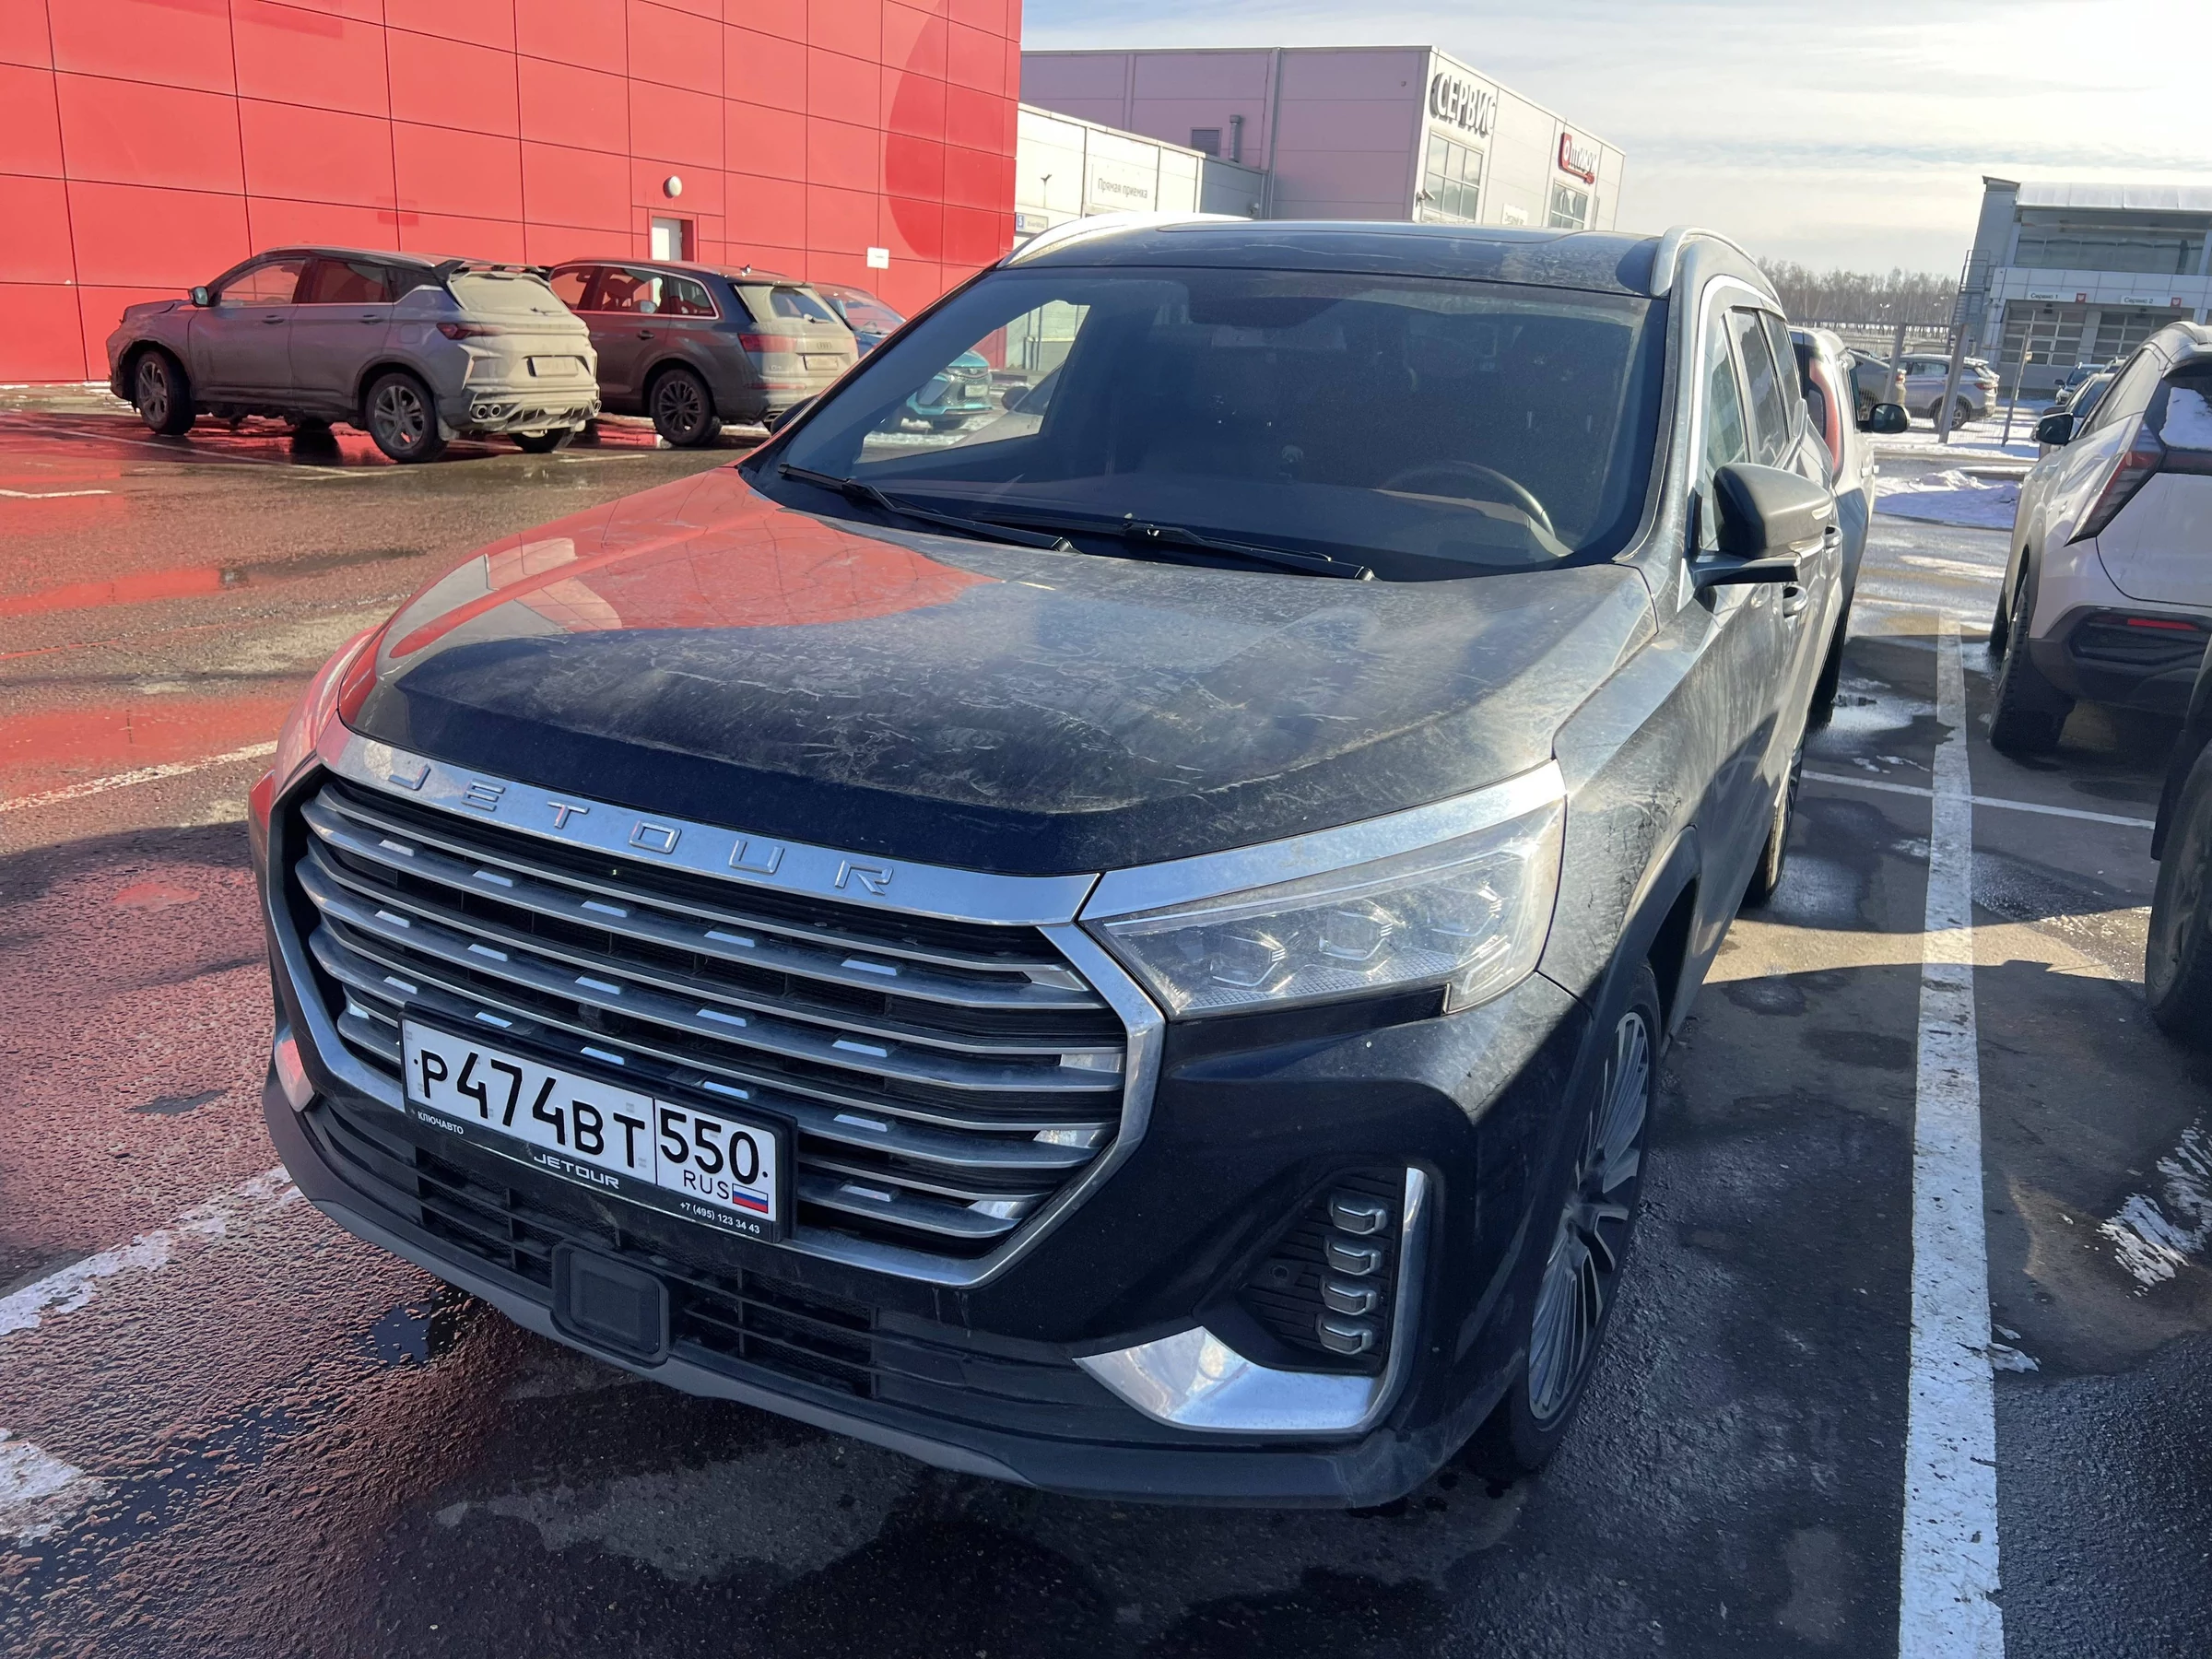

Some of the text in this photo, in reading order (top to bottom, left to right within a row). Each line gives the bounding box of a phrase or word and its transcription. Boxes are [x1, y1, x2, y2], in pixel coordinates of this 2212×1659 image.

[1430, 72, 1497, 137] СЕРВИС
[388, 764, 893, 896] JETOUR
[417, 1111, 465, 1135] КЛЮЧАВТО
[659, 1108, 759, 1184] 550
[533, 1153, 619, 1189] JETOUR
[683, 1171, 730, 1200] RUS
[680, 1202, 760, 1234] +7 (495) 123 34 43
